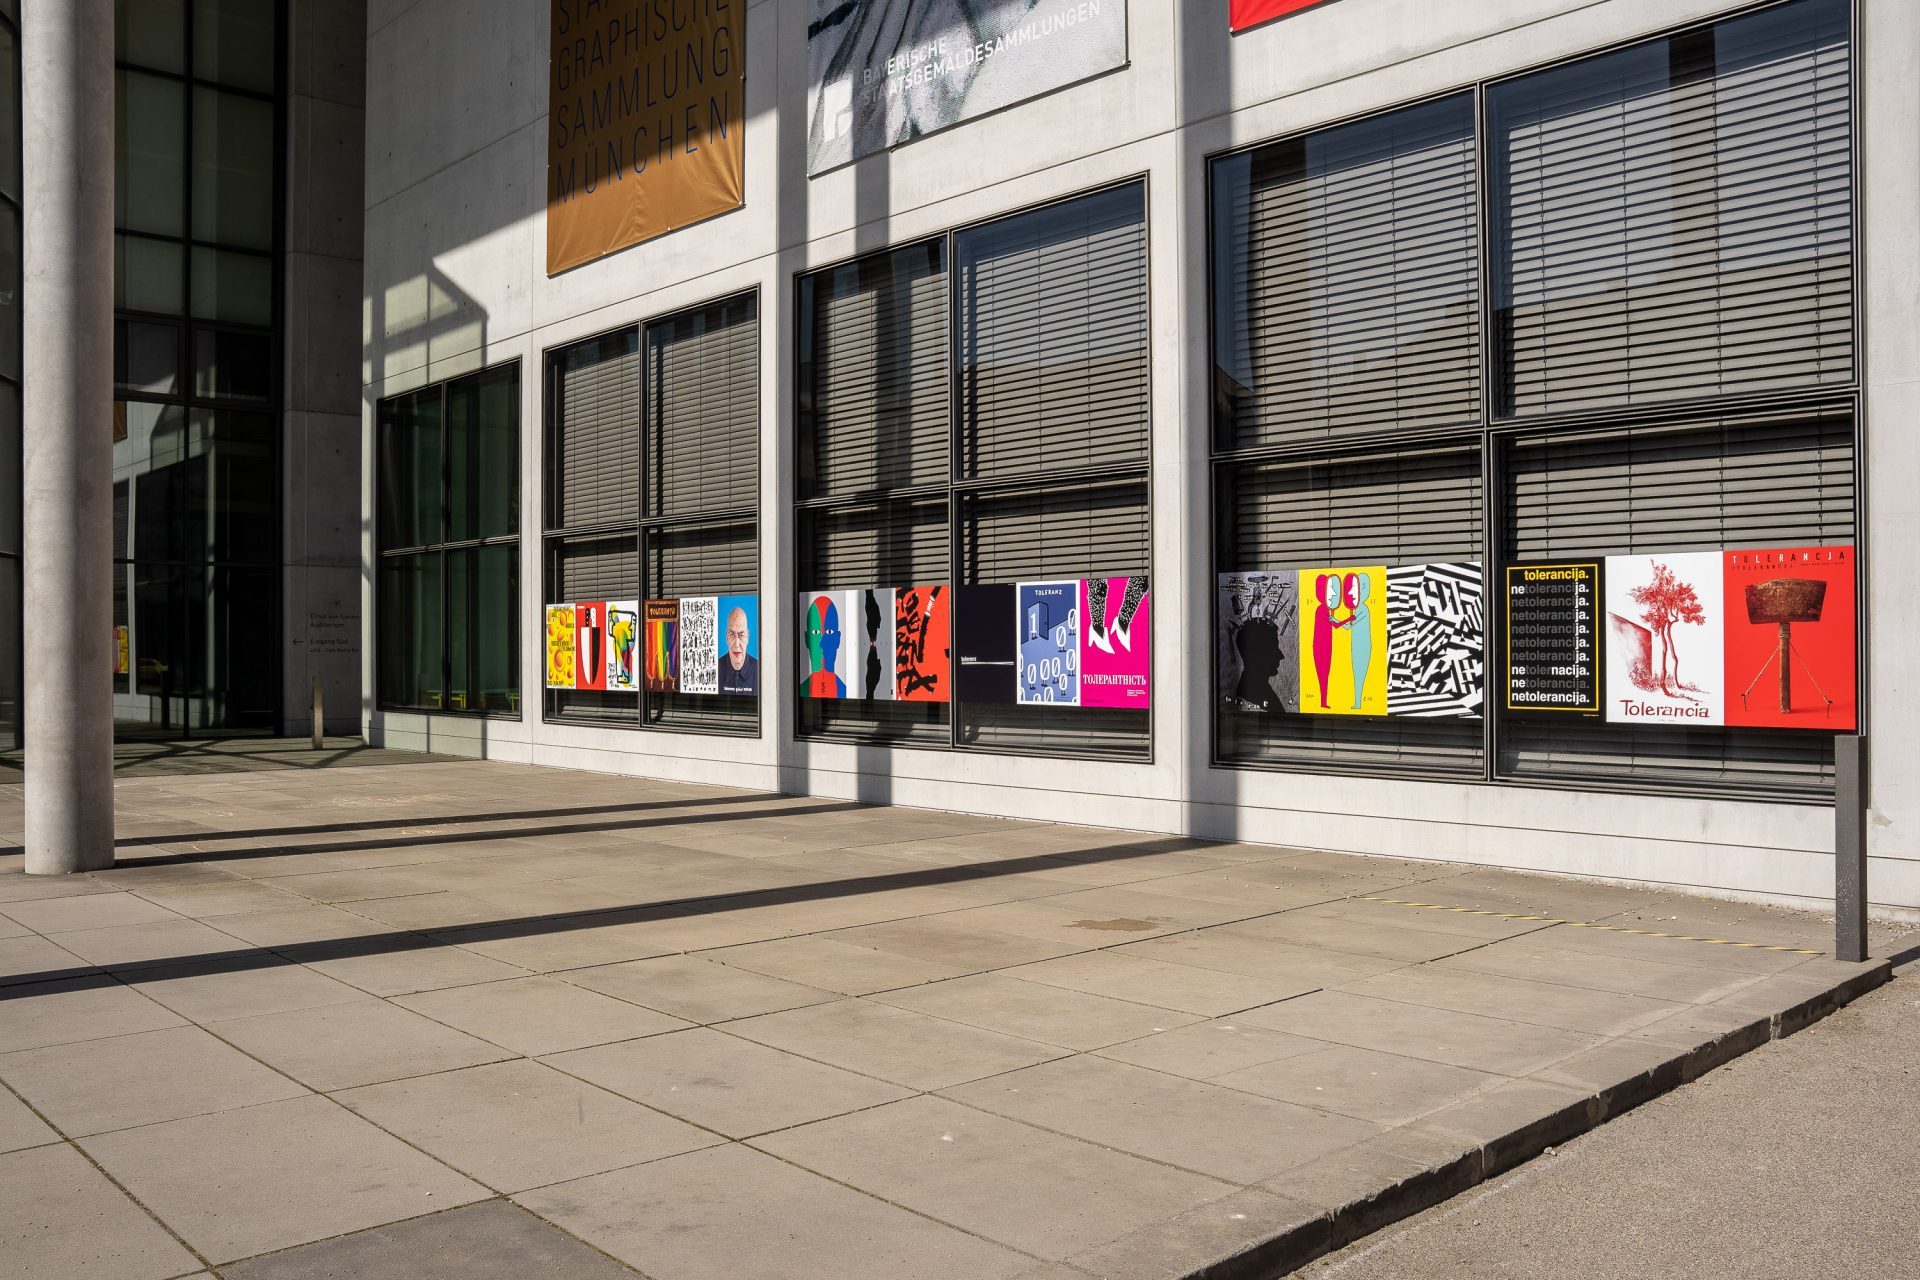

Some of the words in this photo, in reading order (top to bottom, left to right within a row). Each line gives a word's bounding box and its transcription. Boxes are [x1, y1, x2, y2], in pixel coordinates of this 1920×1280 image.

[861, 0, 1100, 106] STAATSGEMÄLDESAMMLUNGEN
[863, 37, 947, 86] BAYERISCHE
[557, 27, 729, 148] SAMMLUNG
[557, 92, 728, 206] MÜNCHEN
[1732, 551, 1845, 564] TOLERANCJA
[1524, 567, 1589, 582] tolerancija.
[1511, 582, 1589, 596] netolerancija.
[1511, 595, 1589, 609] netolerancija.
[1511, 609, 1589, 622] netolerancija.
[1511, 622, 1589, 636] netolerancija.
[1511, 636, 1590, 650] netolerancija.
[1511, 650, 1590, 664] netolerancija.
[1083, 674, 1146, 686] ТОЛЕРАНТНІСТЬ
[1511, 691, 1590, 705] netolerancija.
[1619, 700, 1710, 718] Tolerancia
